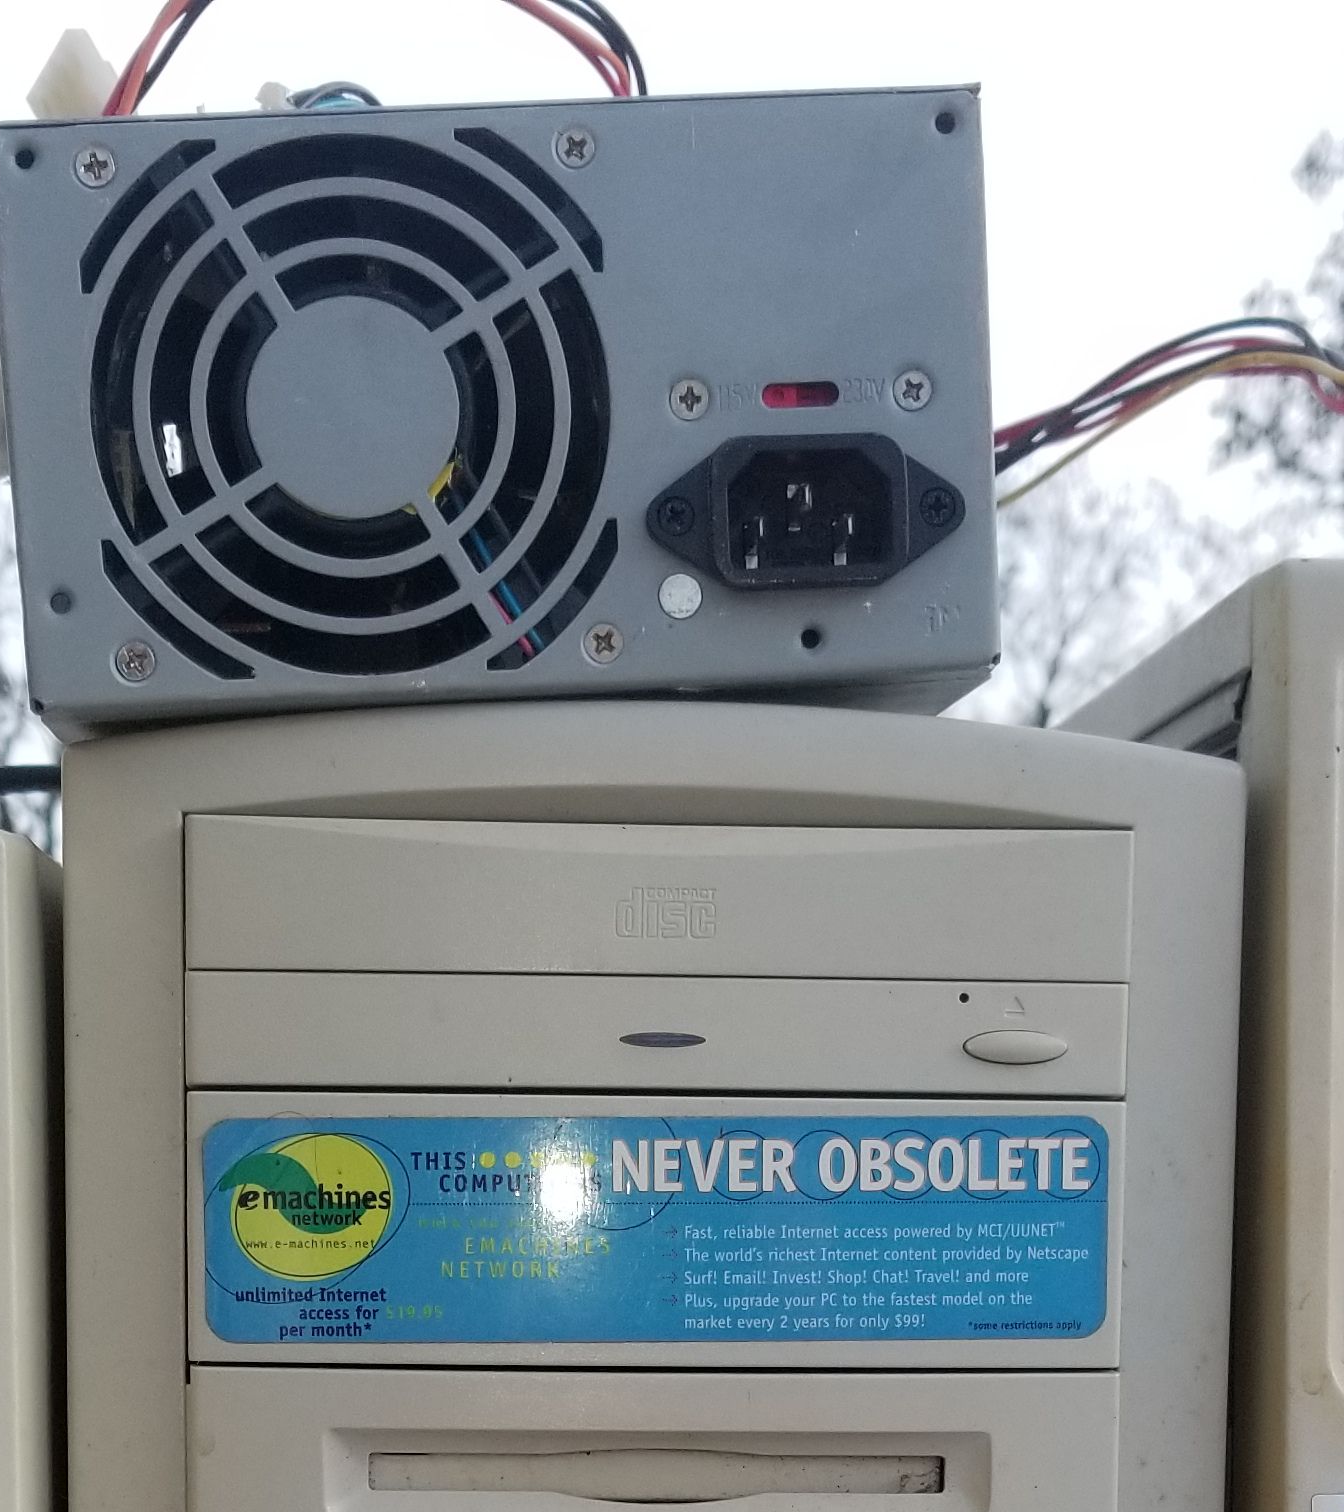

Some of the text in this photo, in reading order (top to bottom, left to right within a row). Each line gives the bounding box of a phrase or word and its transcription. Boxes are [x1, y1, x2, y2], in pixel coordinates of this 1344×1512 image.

[615, 886, 717, 940] disc
[410, 1151, 467, 1171] THIS
[612, 1138, 1092, 1193] NEVER OBSOLETE
[237, 1183, 392, 1211] emachines
[291, 1210, 363, 1226] network
[684, 1225, 718, 1241] Fast,
[723, 1225, 775, 1239] reliable
[781, 1225, 840, 1239] Internet
[843, 1226, 888, 1239] access
[894, 1224, 951, 1241] powered
[956, 1224, 973, 1241] by
[245, 1239, 375, 1250] www.e-machines.net
[464, 1236, 610, 1256] EMACHINES
[684, 1246, 1089, 1263] The world's richest Internet content provided by Netscape
[441, 1260, 560, 1279] NETWORK
[684, 1269, 1030, 1287] Surf! Email! Invest! Shop! Chat! Travel! and more
[234, 1286, 387, 1303] unlimited Internet
[684, 1291, 1033, 1311] Plus, upgrade your PC to the fastest model on the
[299, 1304, 381, 1321] access for
[684, 1313, 926, 1332] market every 2 years for only $99!
[1000, 1320, 1054, 1330] restrictions
[1056, 1320, 1082, 1332] apply
[279, 1325, 304, 1341] per
